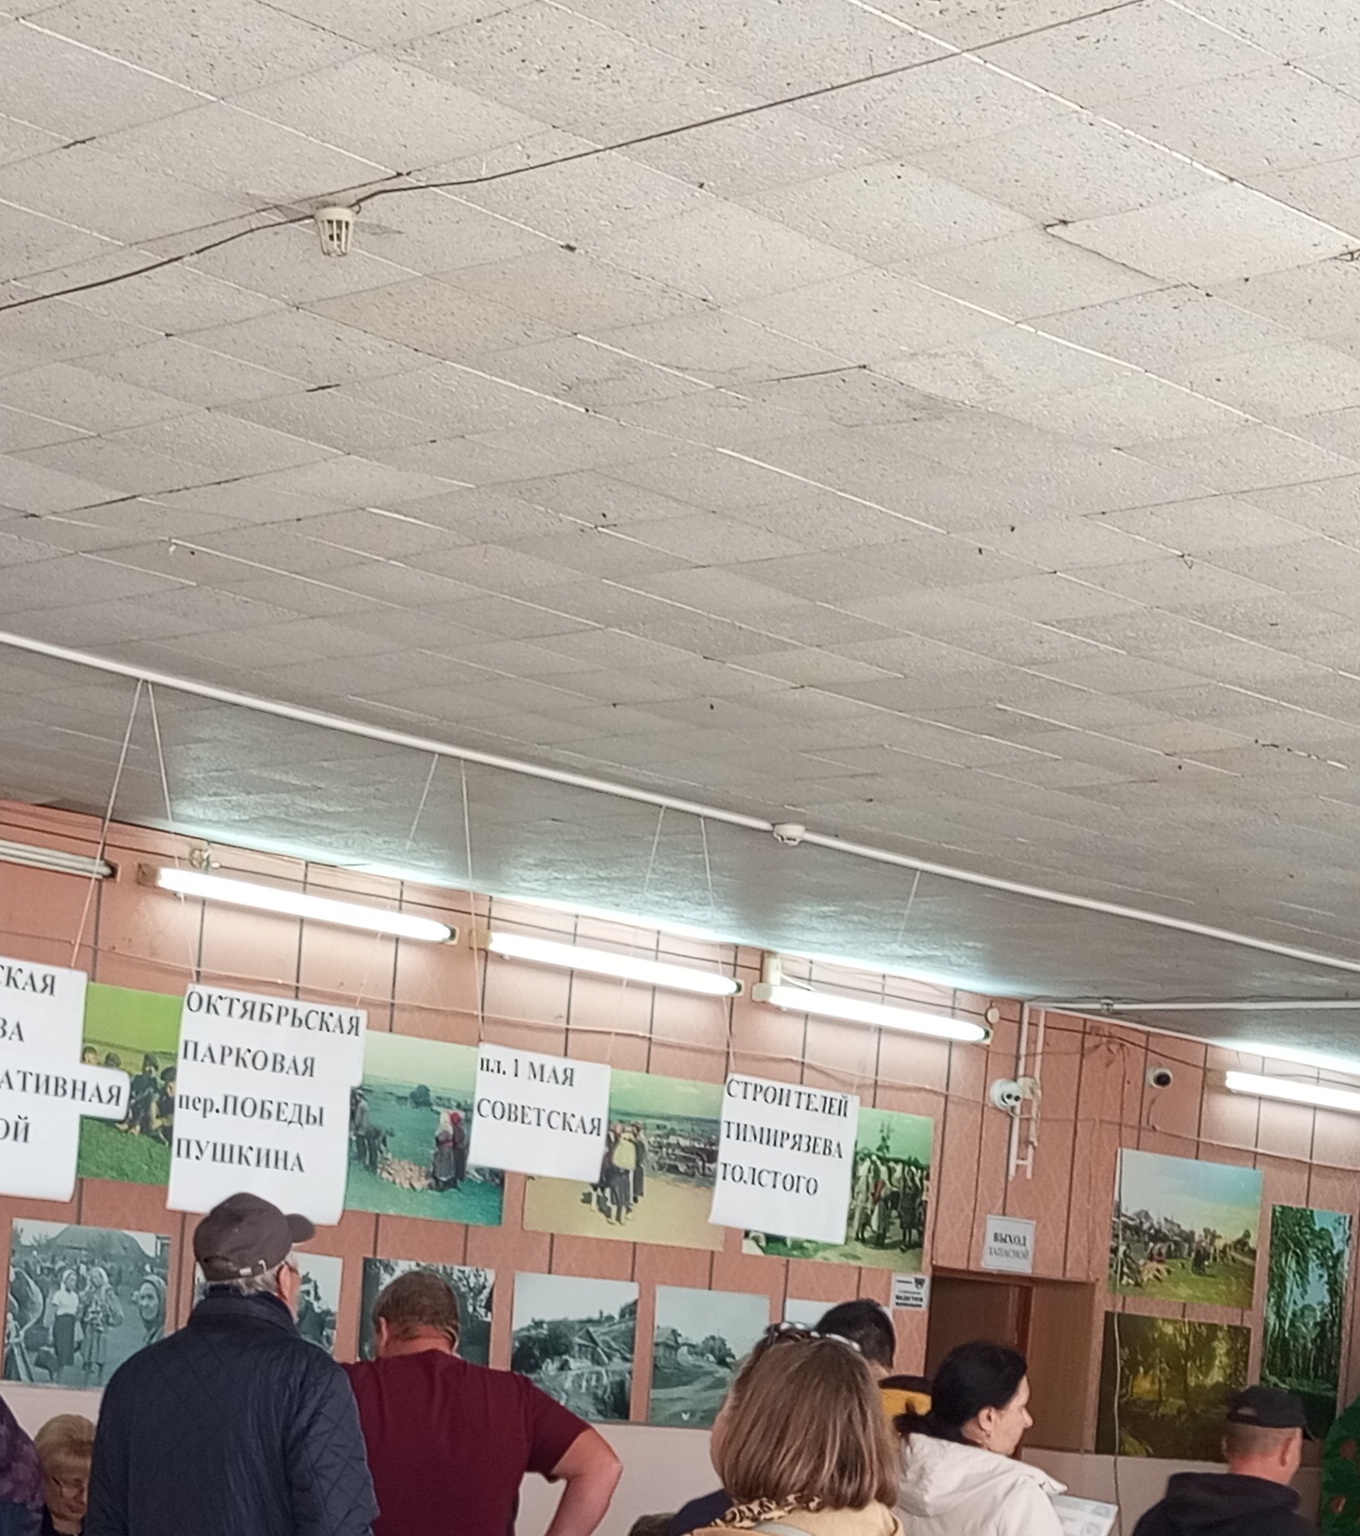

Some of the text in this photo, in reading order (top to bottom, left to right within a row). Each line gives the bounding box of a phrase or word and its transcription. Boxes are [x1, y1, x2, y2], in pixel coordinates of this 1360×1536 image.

[186, 990, 360, 1037] ОКТЯБРЬСКАЯ
[182, 1039, 315, 1078] ПАРКОВАЯ
[479, 1057, 507, 1076] пл.
[528, 1061, 575, 1088] МАЯ
[476, 1097, 602, 1137] СОВЕТСКАЯ
[725, 1077, 849, 1118] СТРОИТЕЛЕЙ
[176, 1137, 305, 1173] ПУШКИНА
[723, 1120, 843, 1159] ТИМИРЯЗЕВА
[720, 1162, 819, 1196] ТОЛСТОГО
